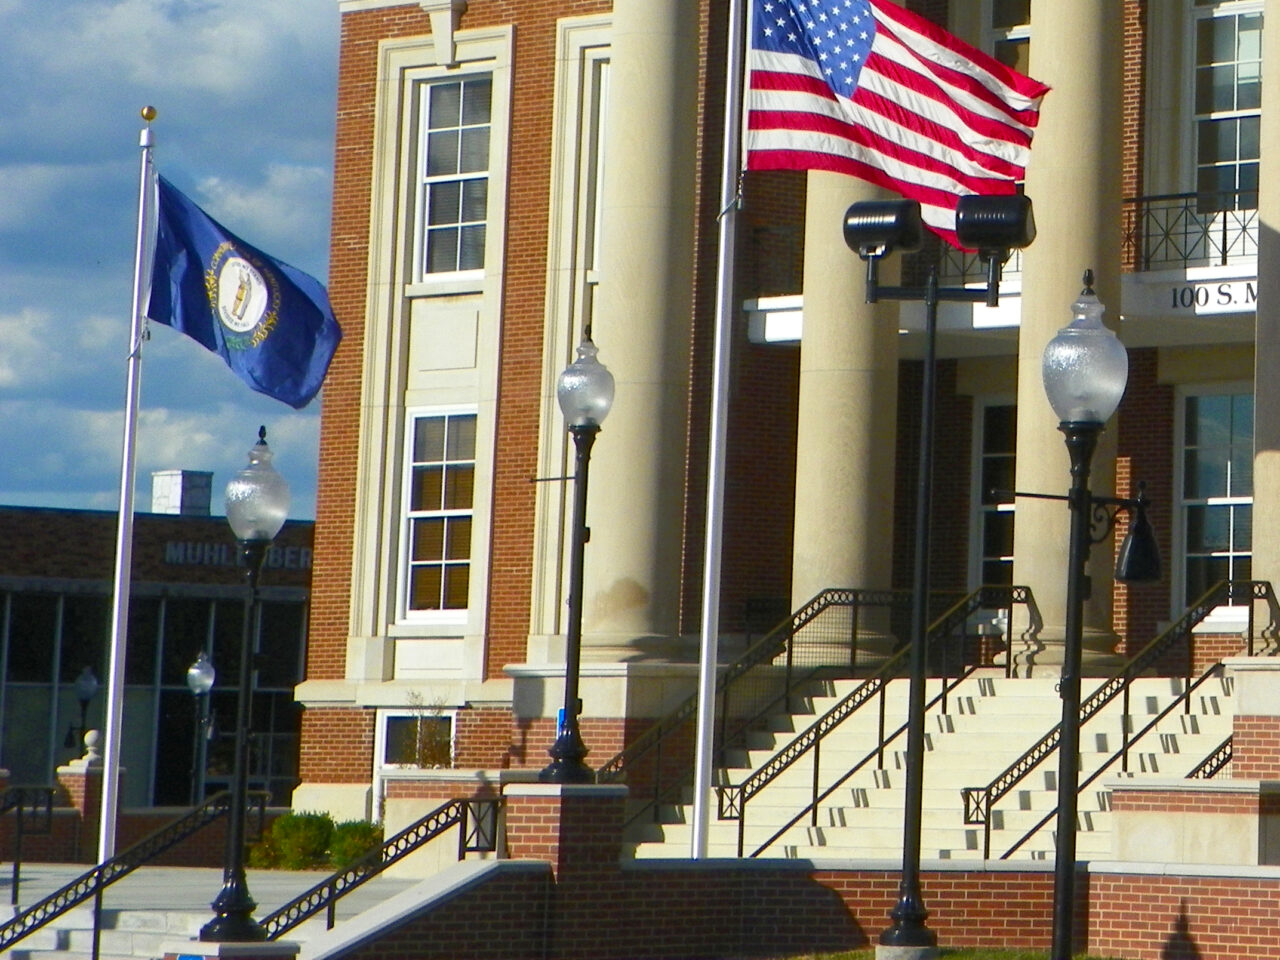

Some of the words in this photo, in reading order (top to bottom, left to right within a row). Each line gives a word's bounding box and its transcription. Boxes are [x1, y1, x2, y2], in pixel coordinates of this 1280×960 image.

[1171, 286, 1209, 308] 100
[1217, 283, 1238, 305] S.
[164, 541, 313, 569] MUHLEBER
